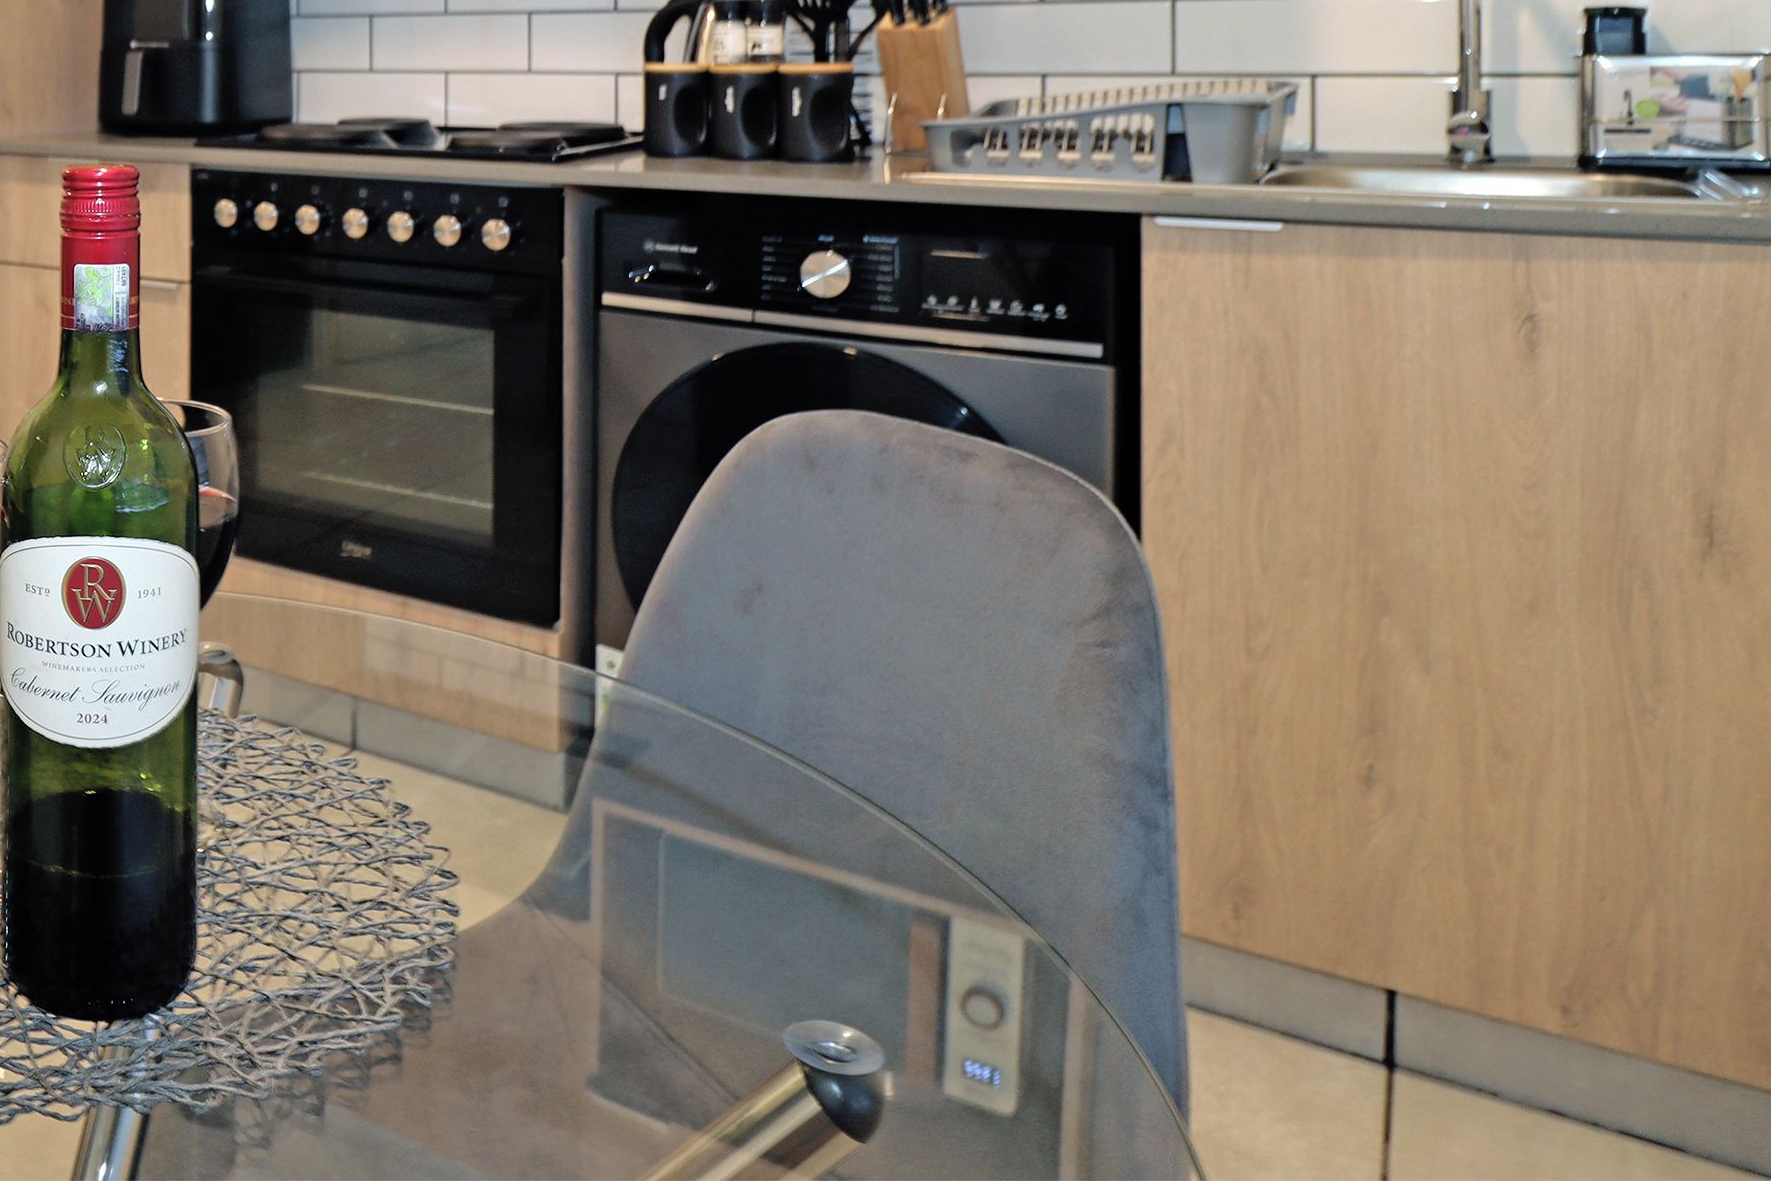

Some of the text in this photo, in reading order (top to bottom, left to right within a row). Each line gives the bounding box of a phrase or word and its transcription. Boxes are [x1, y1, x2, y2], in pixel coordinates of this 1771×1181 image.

[137, 586, 162, 599] 1941
[6, 621, 187, 658] ROBERTSON WINERY
[41, 660, 146, 673] WINEMAKERS SELECTION
[10, 667, 180, 712] Cabernet Sauvignon
[76, 713, 109, 725] 2024
